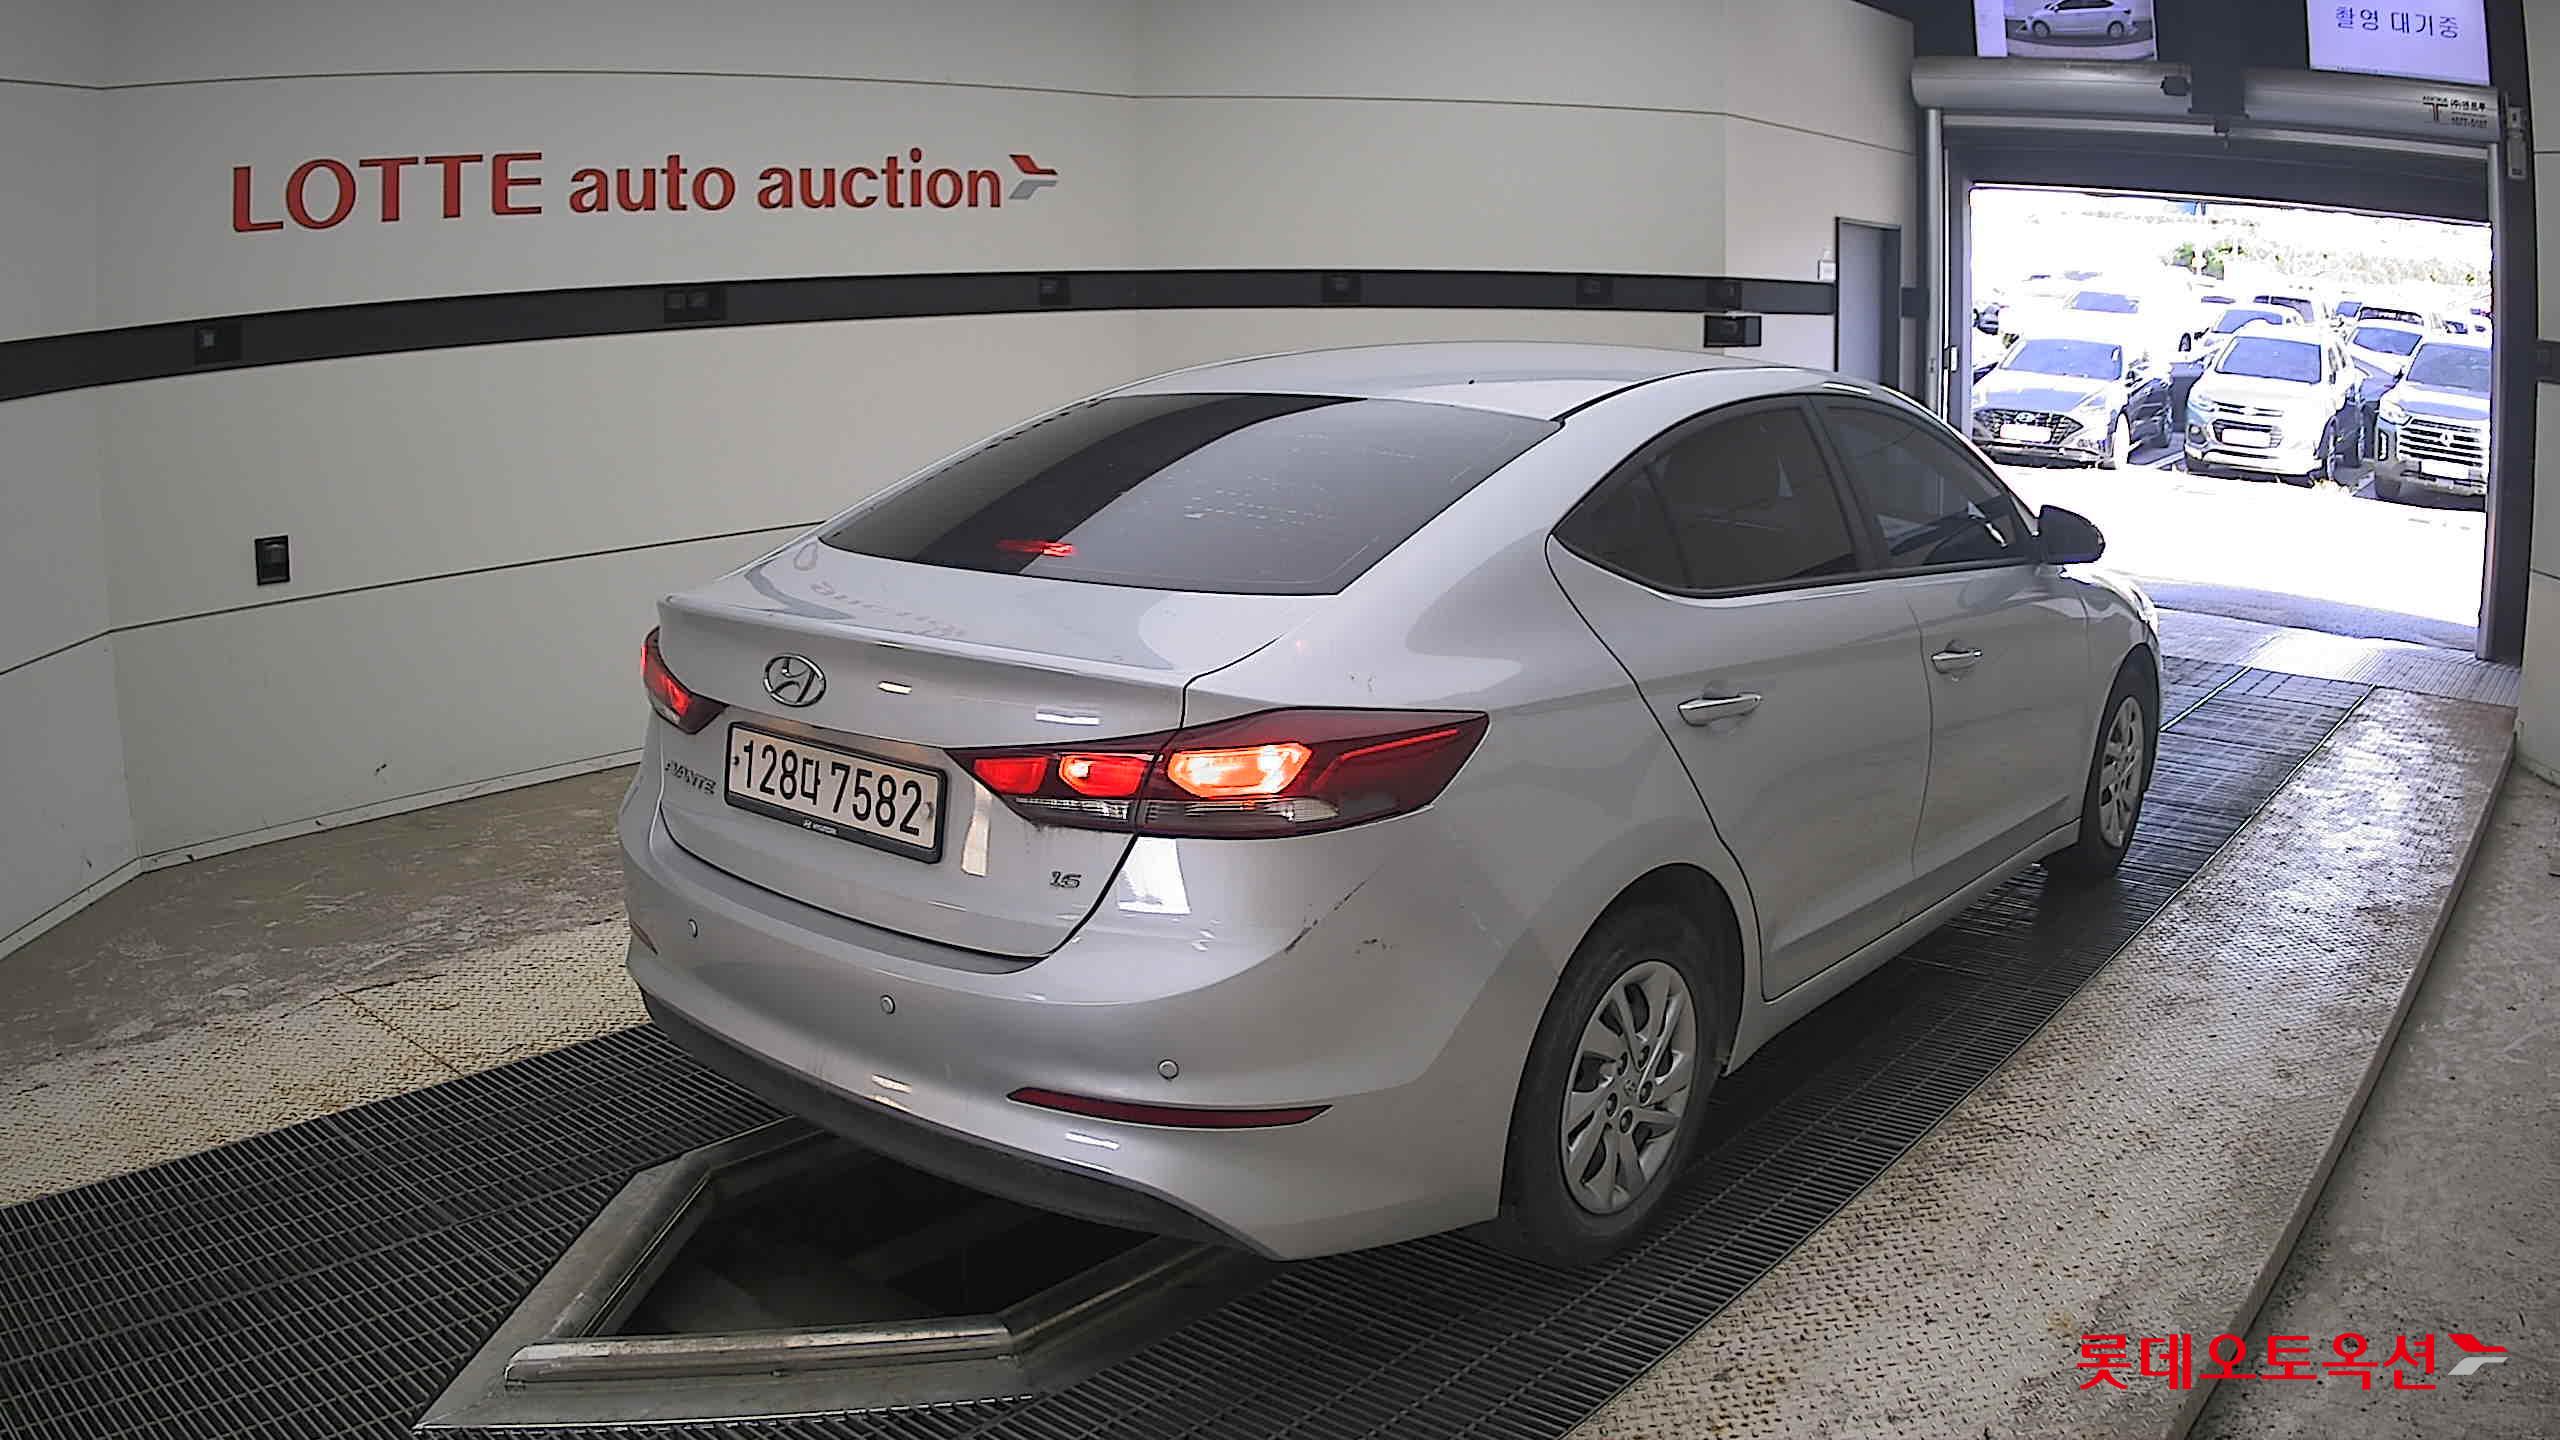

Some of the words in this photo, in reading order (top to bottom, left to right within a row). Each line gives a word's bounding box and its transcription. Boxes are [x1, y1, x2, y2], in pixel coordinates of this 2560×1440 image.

[2390, 12, 2459, 40] 대기중
[232, 152, 544, 233] LOTTE
[568, 154, 736, 214] auto
[757, 148, 1003, 210] auction
[743, 740, 822, 806] 128다
[830, 760, 924, 837] 7582
